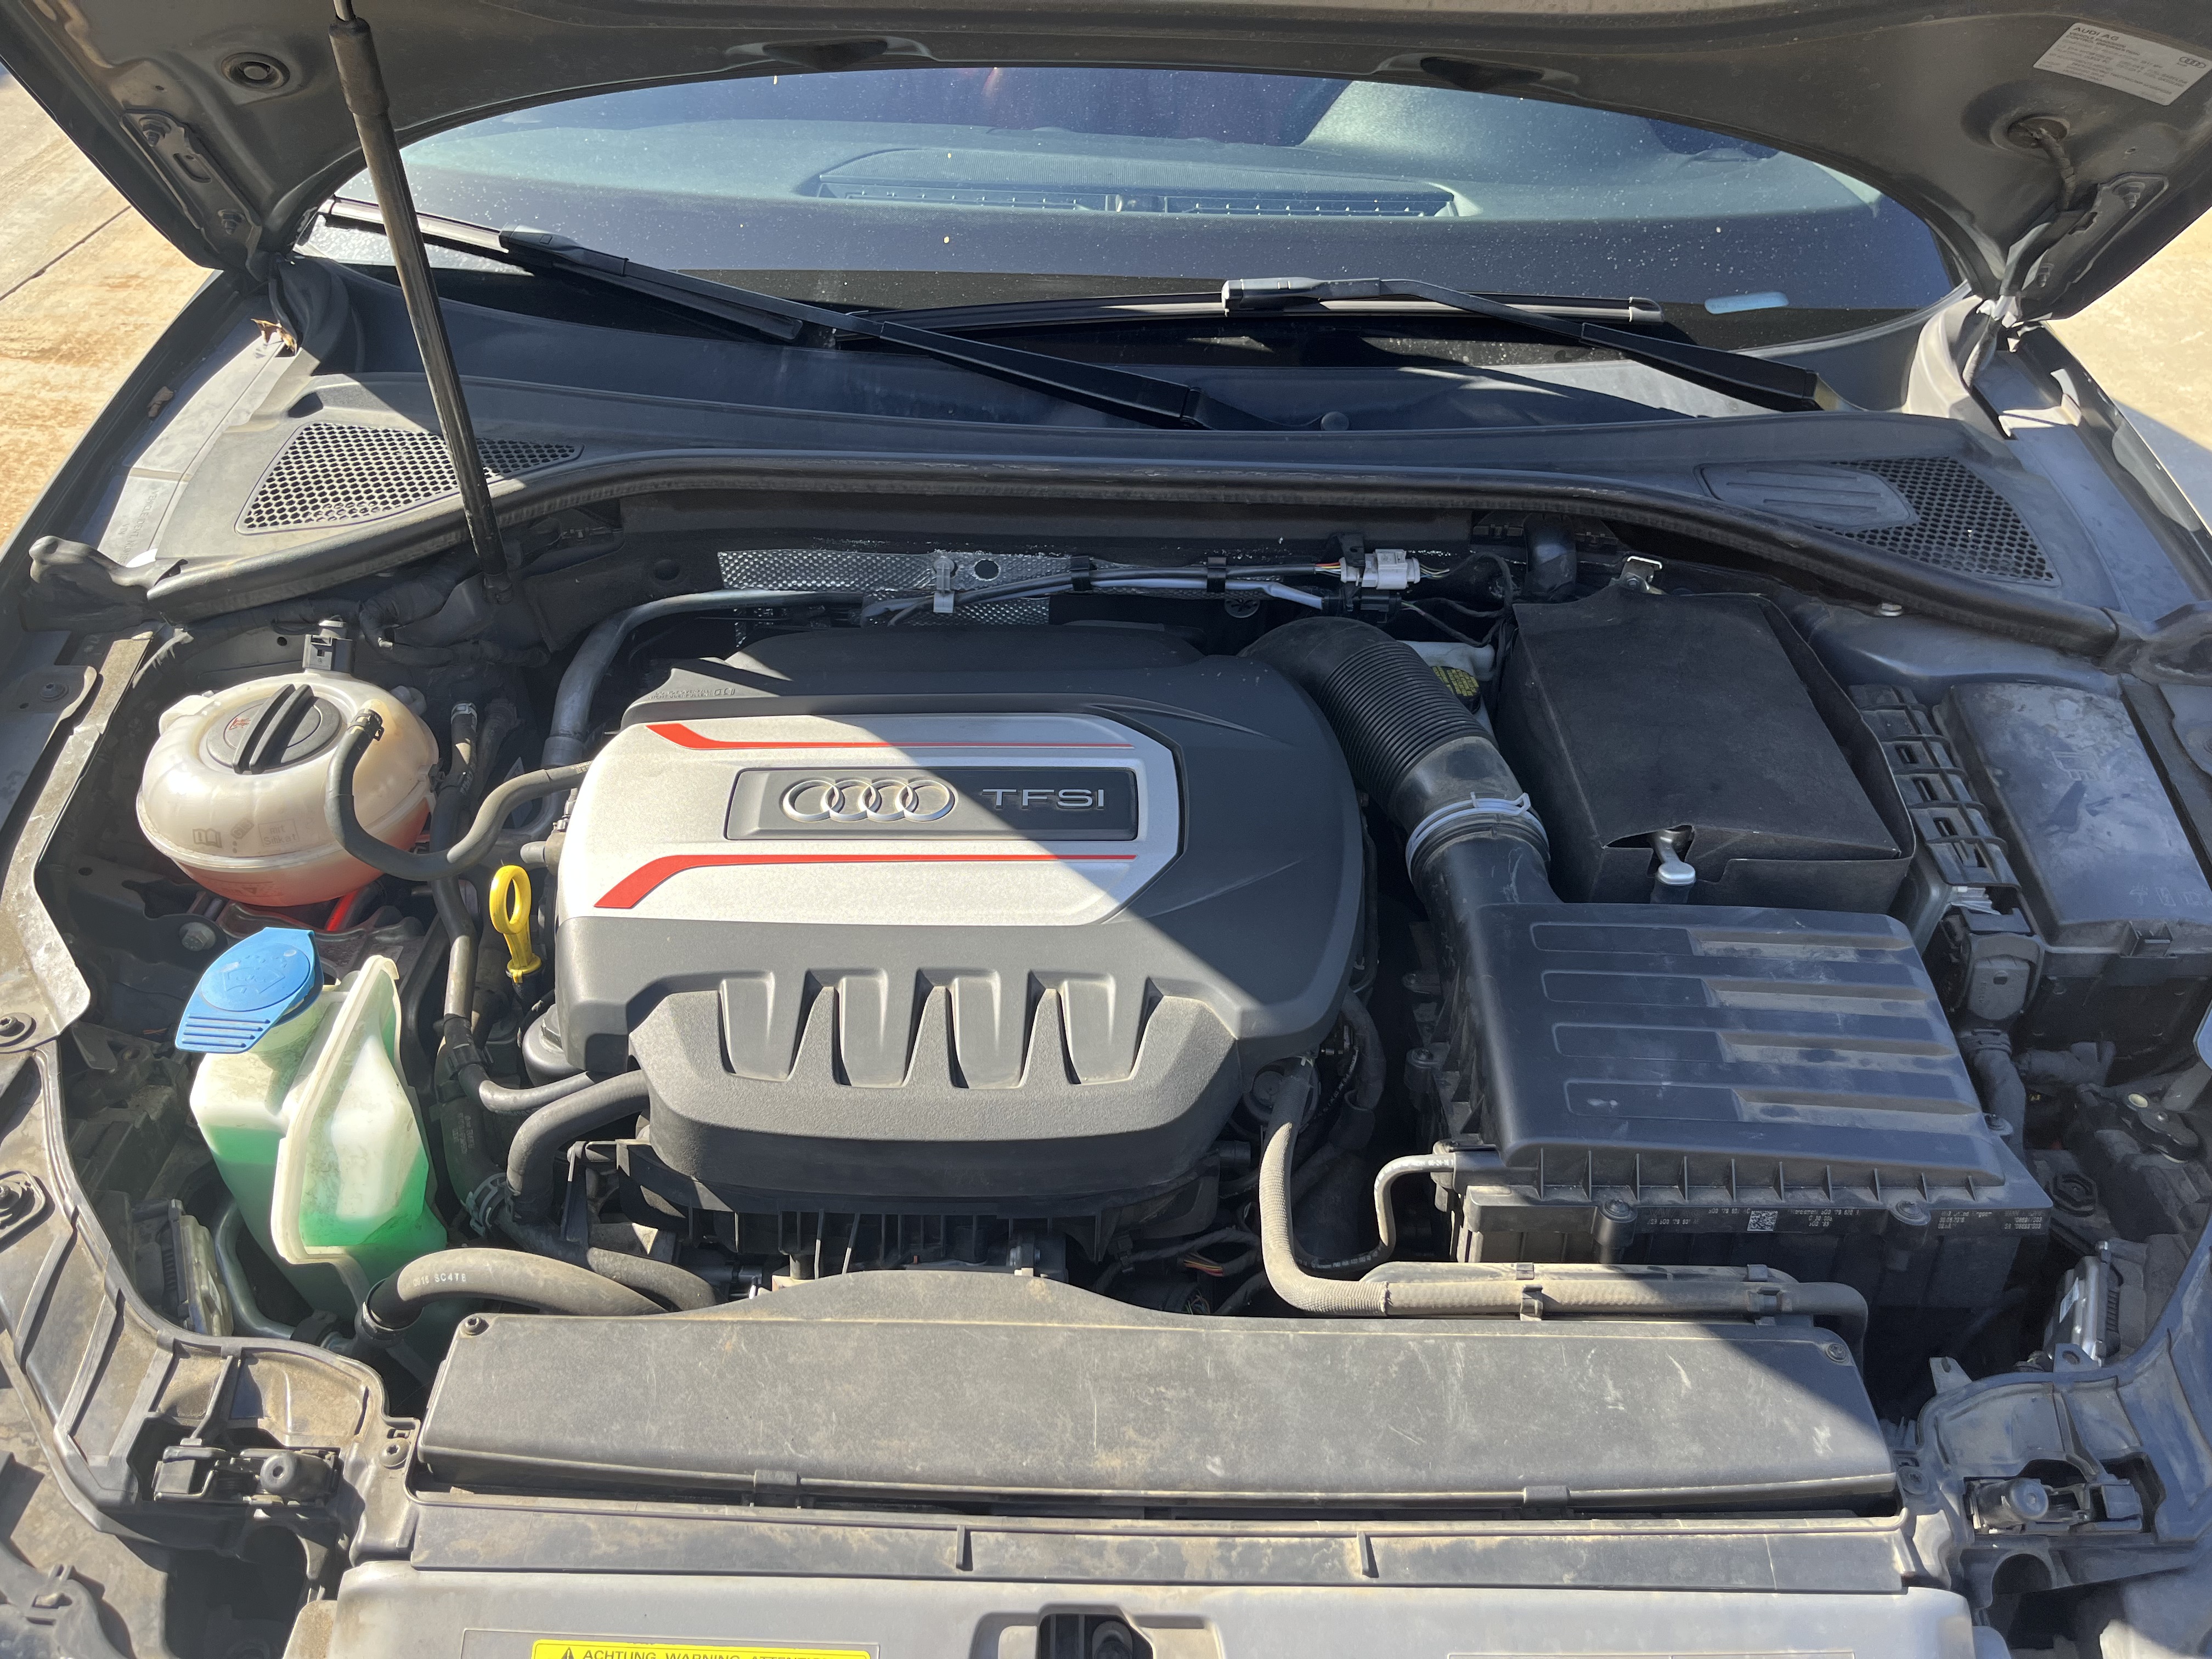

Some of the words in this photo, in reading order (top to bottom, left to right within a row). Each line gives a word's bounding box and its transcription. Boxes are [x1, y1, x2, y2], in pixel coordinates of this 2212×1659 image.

[2073, 27, 2101, 36] AUDI
[982, 788, 1105, 809] TFSI
[583, 1650, 657, 1659] ACHTUNG
